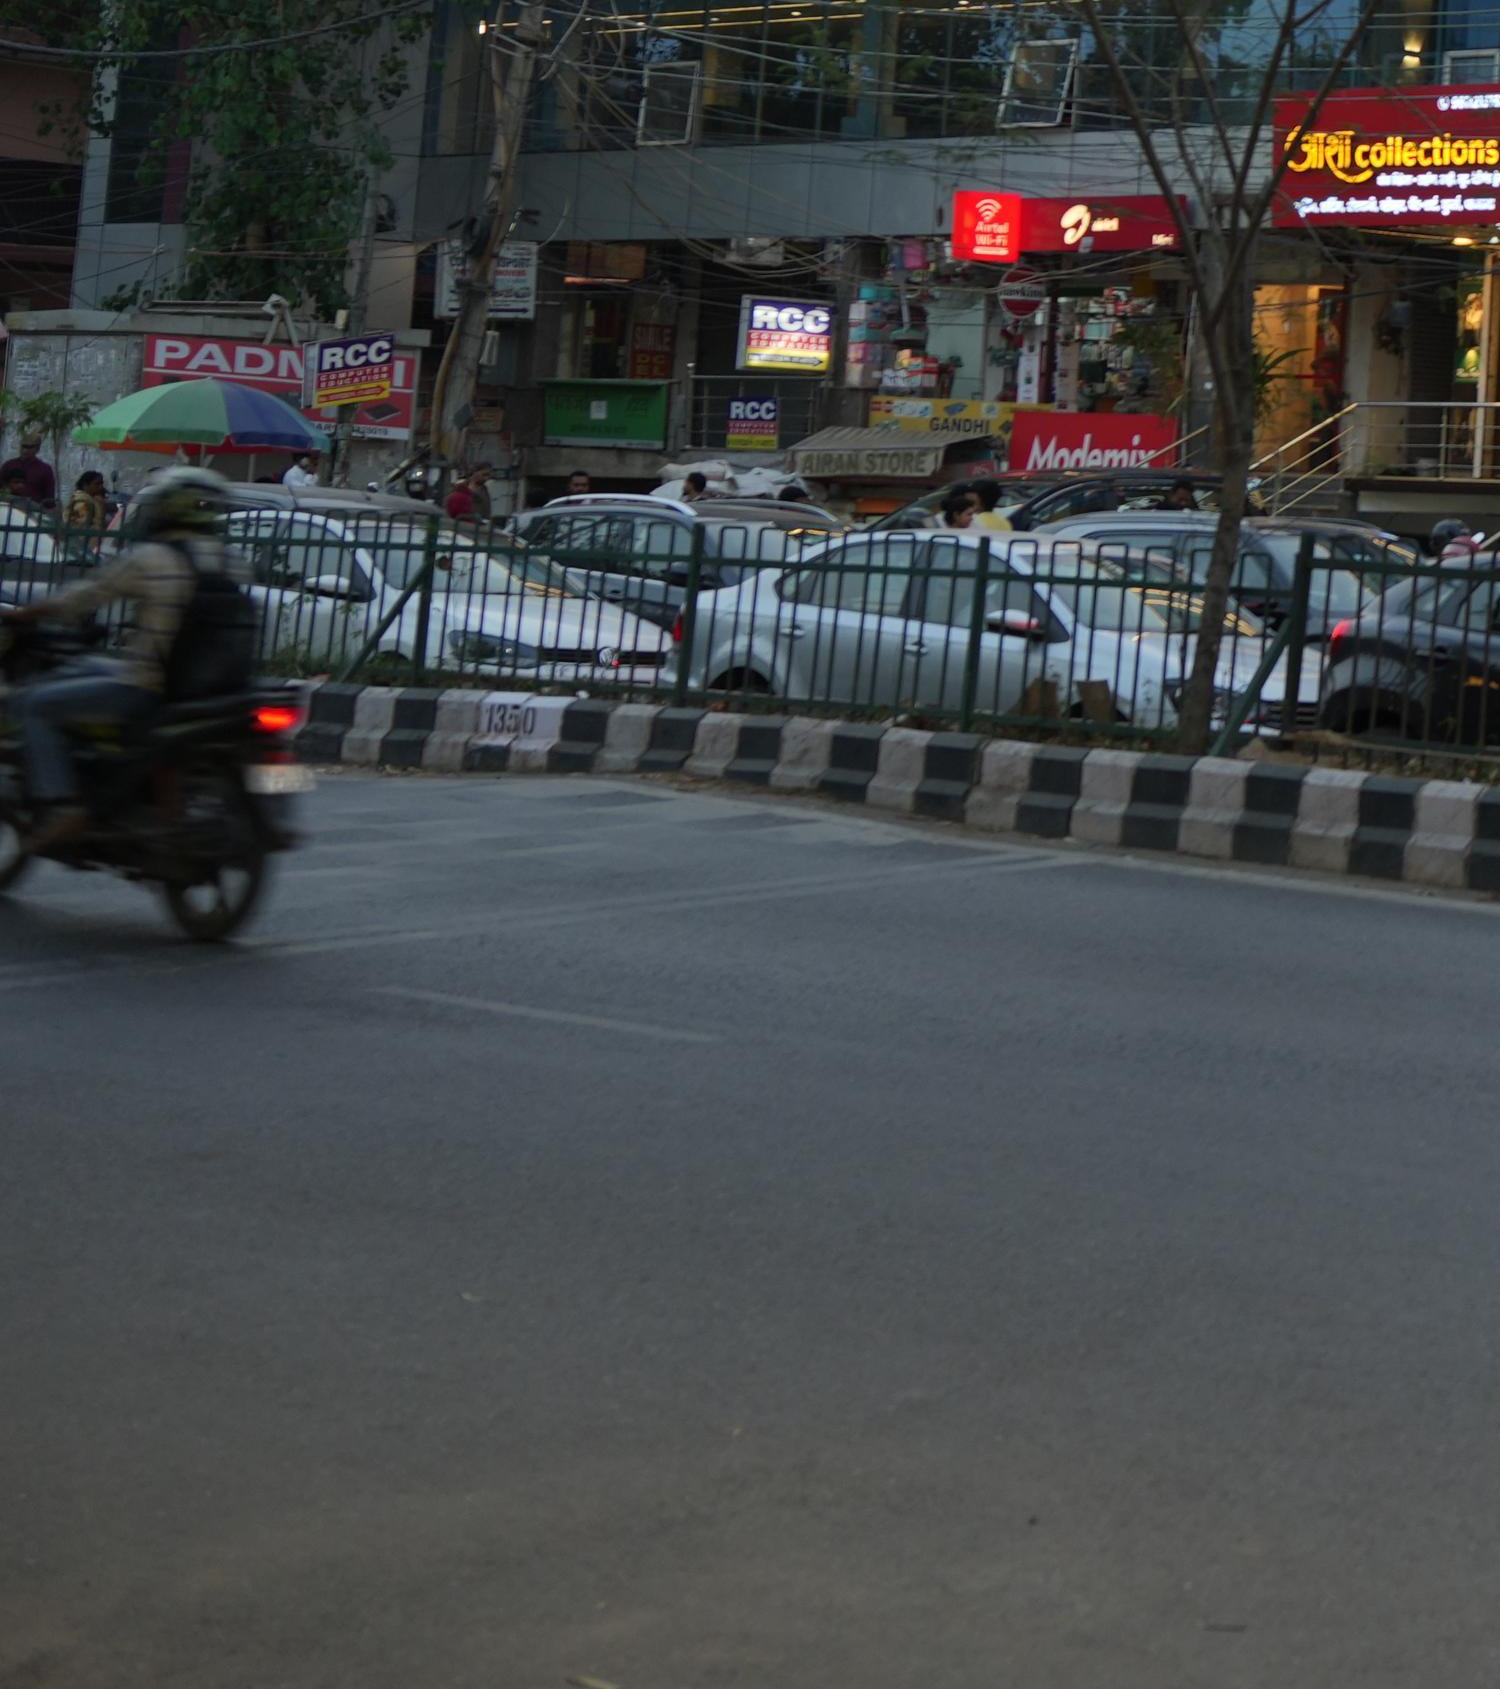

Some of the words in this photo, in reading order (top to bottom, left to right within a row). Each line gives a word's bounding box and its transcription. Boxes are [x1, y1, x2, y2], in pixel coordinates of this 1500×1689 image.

[1355, 133, 1500, 168] collections
[975, 221, 1009, 234] Airtel
[753, 305, 831, 333] RCC
[321, 340, 392, 371] RCC
[730, 401, 776, 420] RCC
[929, 416, 990, 435] GANDHI
[864, 450, 927, 474] STORE
